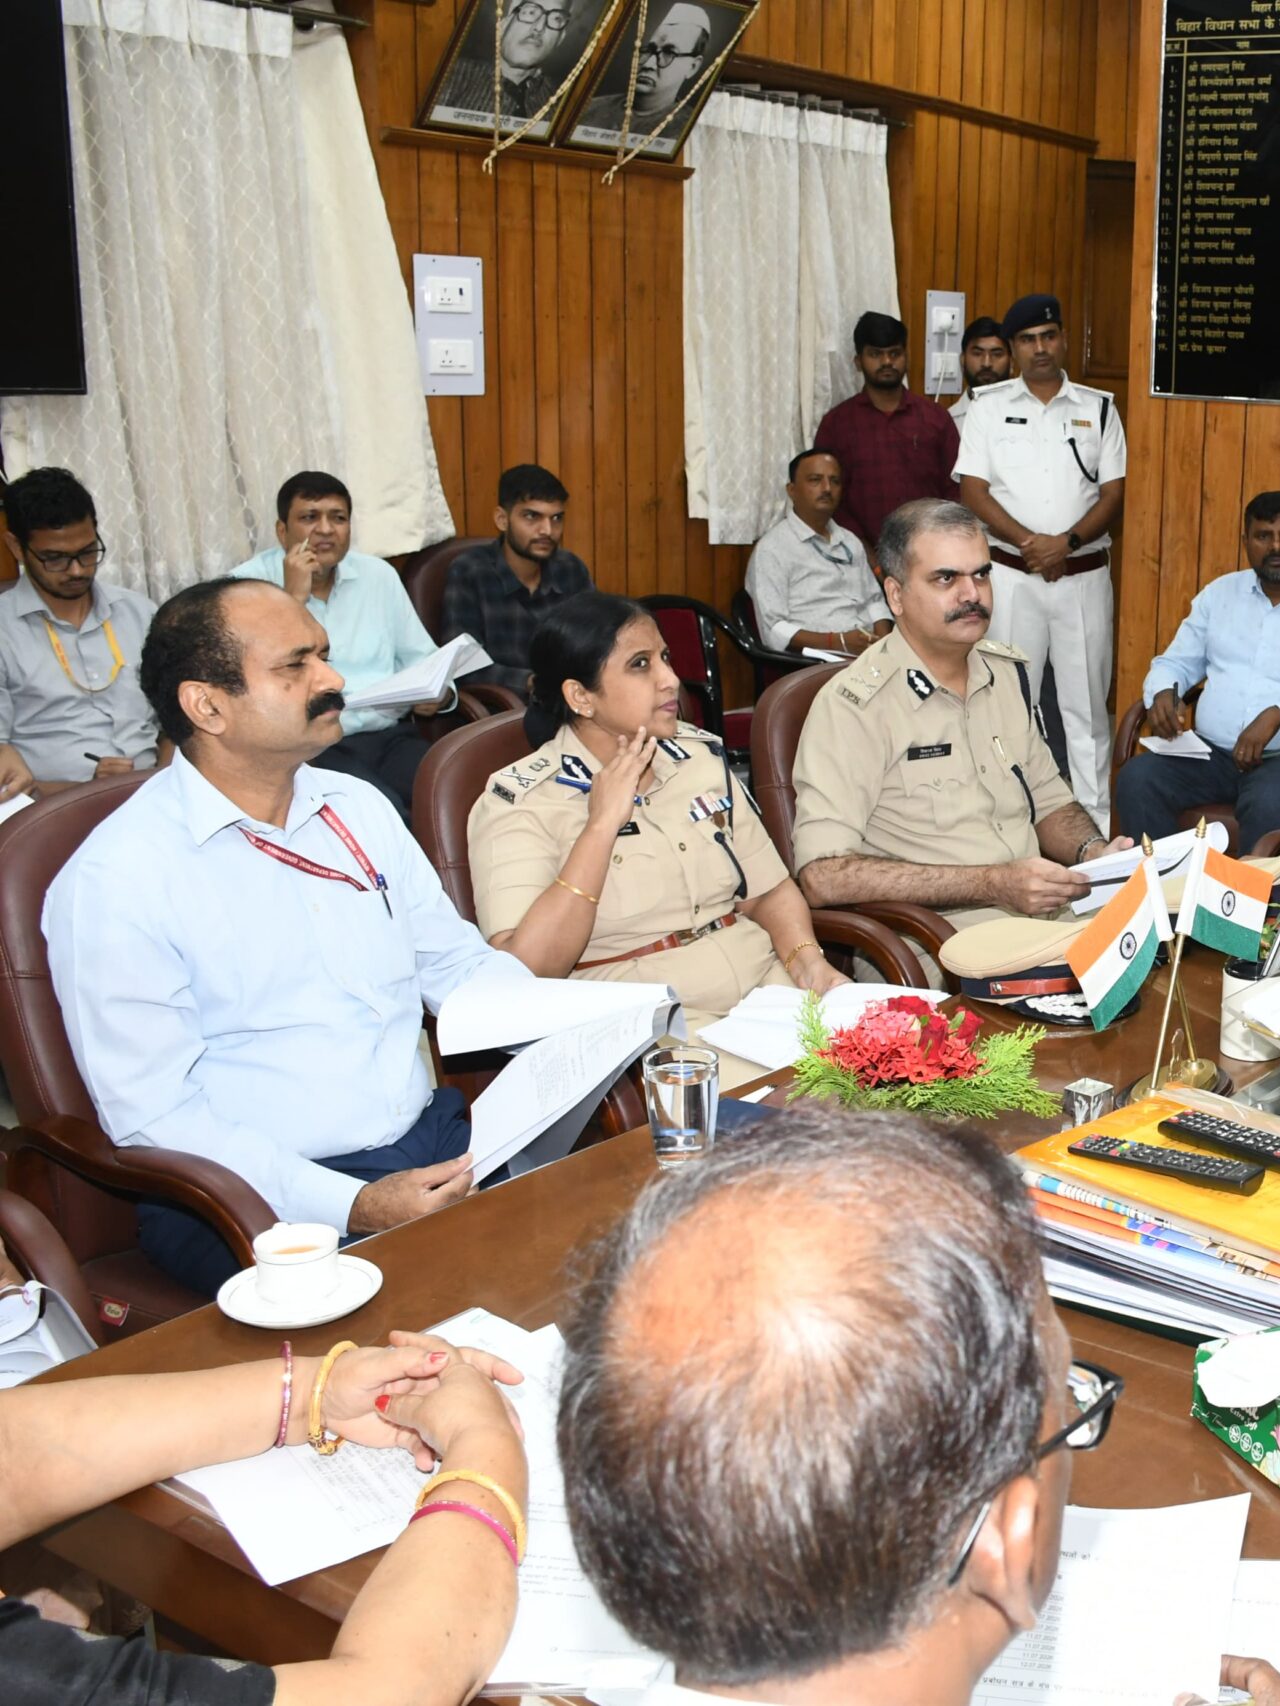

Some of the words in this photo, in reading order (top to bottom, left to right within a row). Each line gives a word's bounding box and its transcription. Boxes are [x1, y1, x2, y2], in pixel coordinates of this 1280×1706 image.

[1251, 1, 1272, 13] बिहार
[1176, 18, 1202, 33] बिहार
[1205, 17, 1235, 31] विधान
[1239, 19, 1260, 30] सभा
[1264, 15, 1275, 29] के
